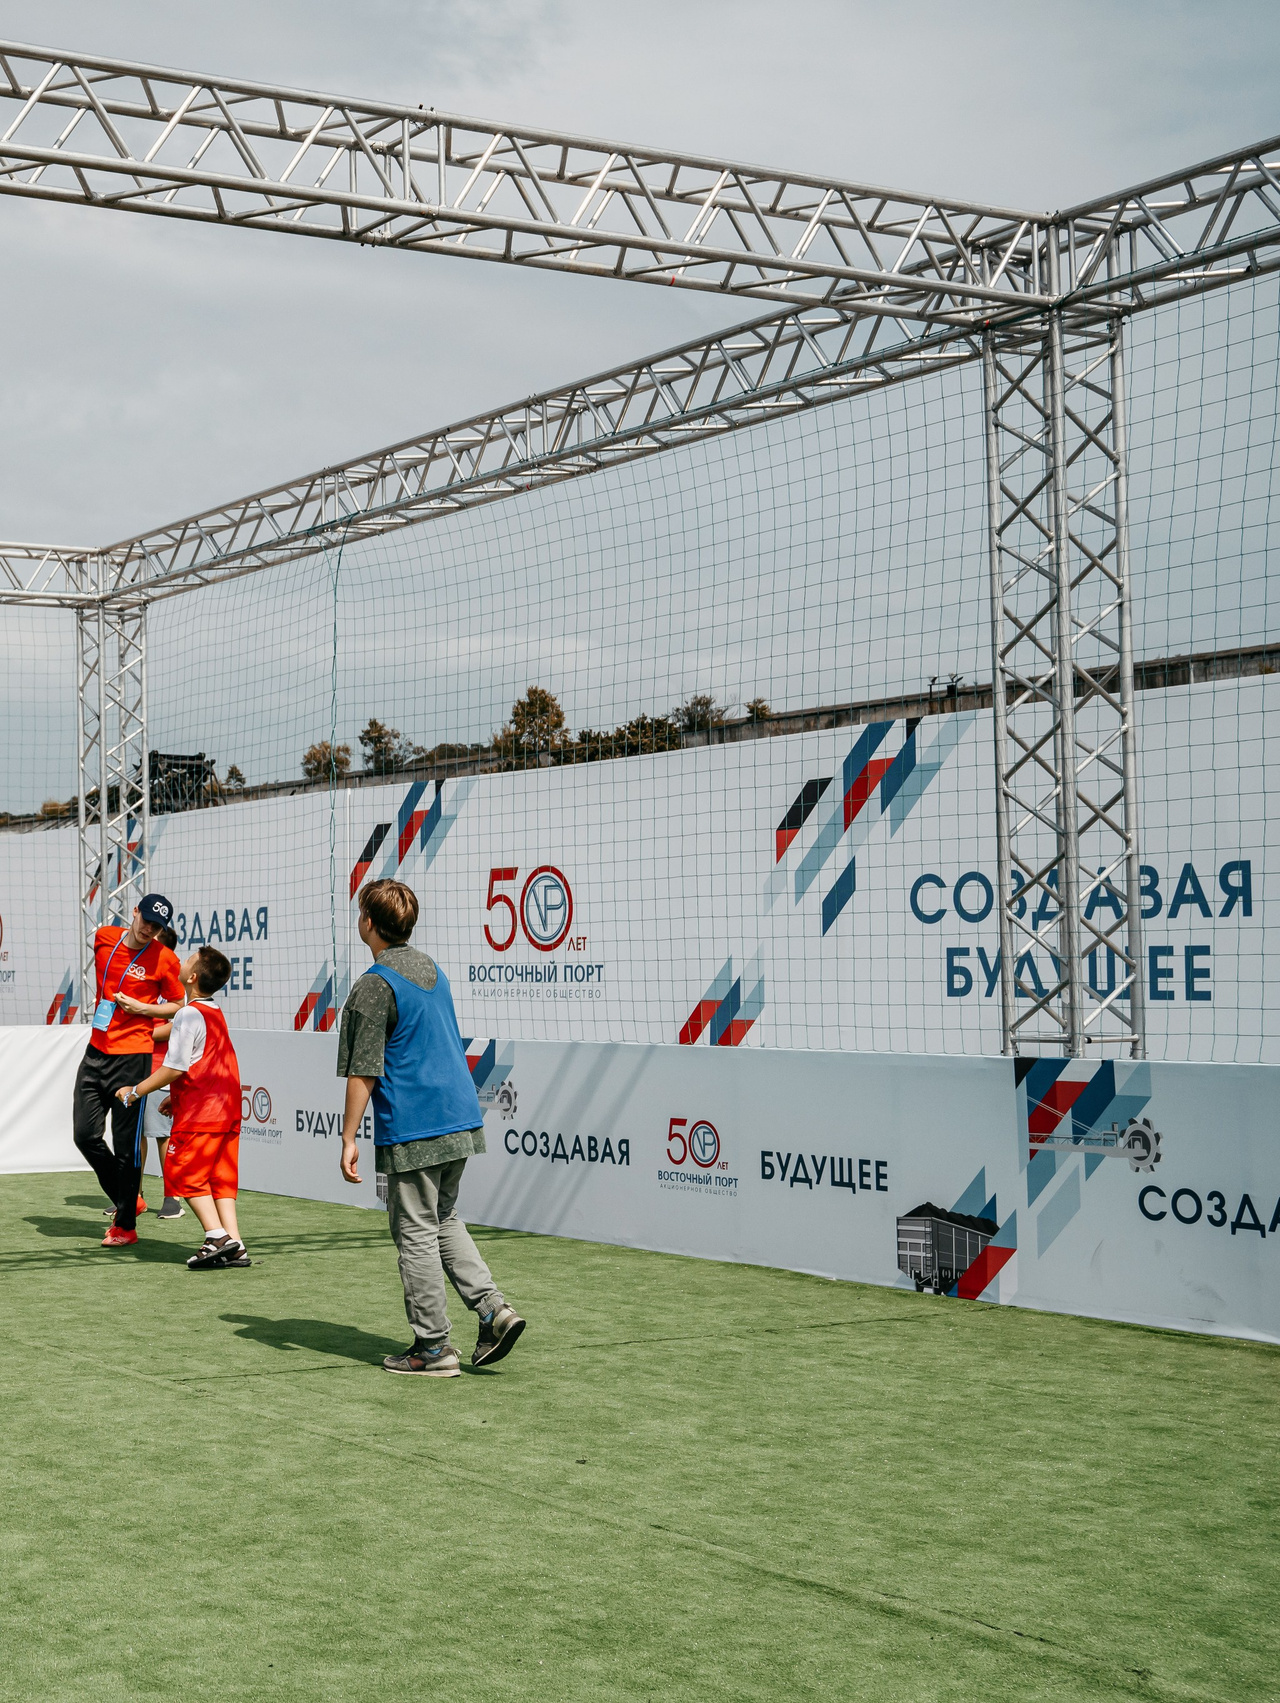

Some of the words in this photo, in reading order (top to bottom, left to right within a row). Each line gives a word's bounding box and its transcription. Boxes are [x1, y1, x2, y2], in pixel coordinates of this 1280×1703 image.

[152, 902, 169, 917] 50
[484, 865, 573, 952] 50
[567, 937, 587, 951] ЛЕТ
[170, 906, 268, 950] ЗДАВАЯ
[469, 961, 557, 982] ВОСТОЧНЫЙ
[564, 965, 603, 982] ПОРТ
[472, 988, 540, 998] АКЦИОНЕРНОЕ
[546, 989, 601, 999] ОБЩЕСТВО
[268, 1129, 282, 1139] ПОРТ
[296, 1109, 372, 1140] БУДУЕ
[504, 1129, 630, 1166] СОЗДАВАЯ
[666, 1117, 720, 1168] 50
[717, 1161, 728, 1170] ЛЕТ
[657, 1170, 712, 1186] ВОСТОЧНЫЙ
[715, 1176, 738, 1189] ПОРТ
[761, 1150, 888, 1194] БУДУЩЕЕ
[660, 1183, 702, 1193] АКЦИОНЕРНОЕ
[705, 1188, 738, 1197] ОБЩЕСТВО
